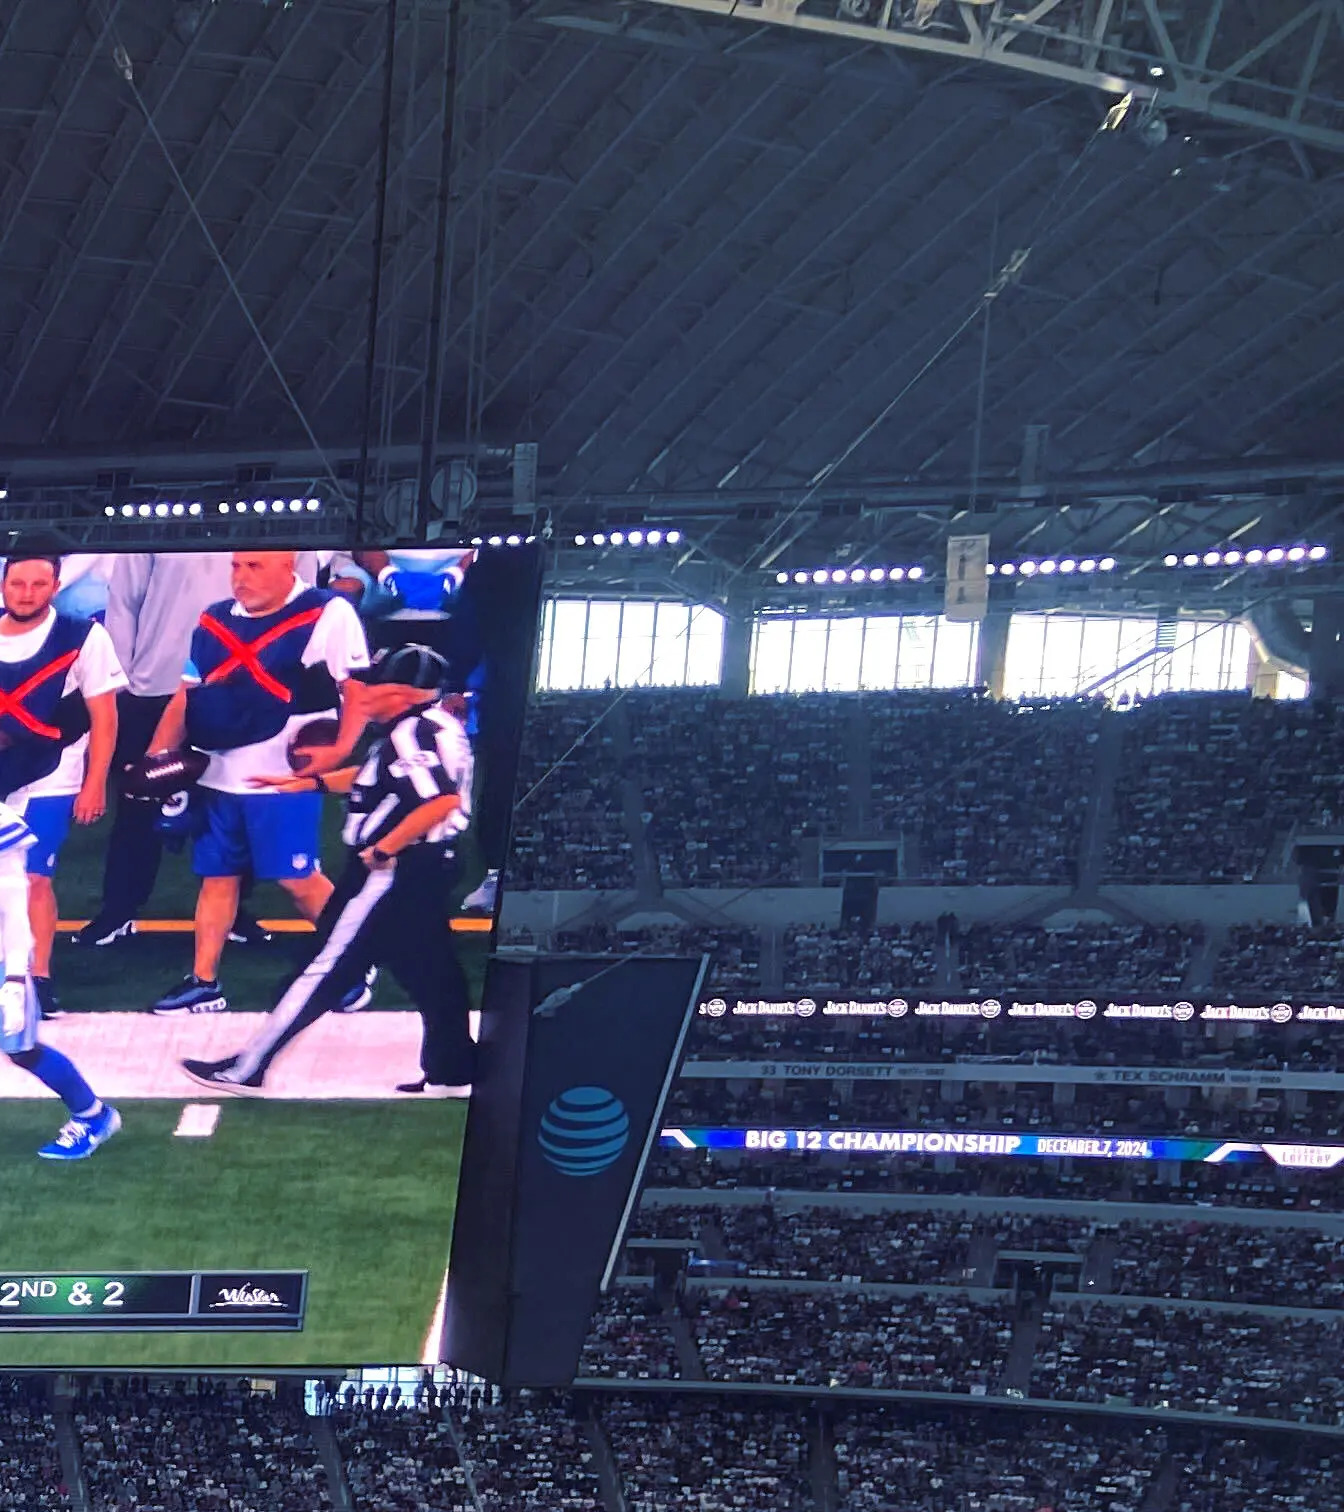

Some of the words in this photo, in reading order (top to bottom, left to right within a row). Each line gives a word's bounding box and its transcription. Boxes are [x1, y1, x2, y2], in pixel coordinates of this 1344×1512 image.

[761, 1065, 776, 1075] 33
[784, 1066, 820, 1076] TONY
[826, 1066, 894, 1077] DORSETT
[1114, 1071, 1143, 1082] TEX
[1148, 1071, 1226, 1084] SCHRAMM
[745, 1130, 787, 1149] BIG
[796, 1131, 822, 1149] 12
[828, 1132, 1021, 1153] CHAMPIONSHIP
[1038, 1138, 1100, 1155] DECEMBER
[1116, 1140, 1148, 1156] 2024
[0, 1282, 58, 1308] 2ND
[67, 1282, 96, 1308] &
[102, 1281, 125, 1308] 2
